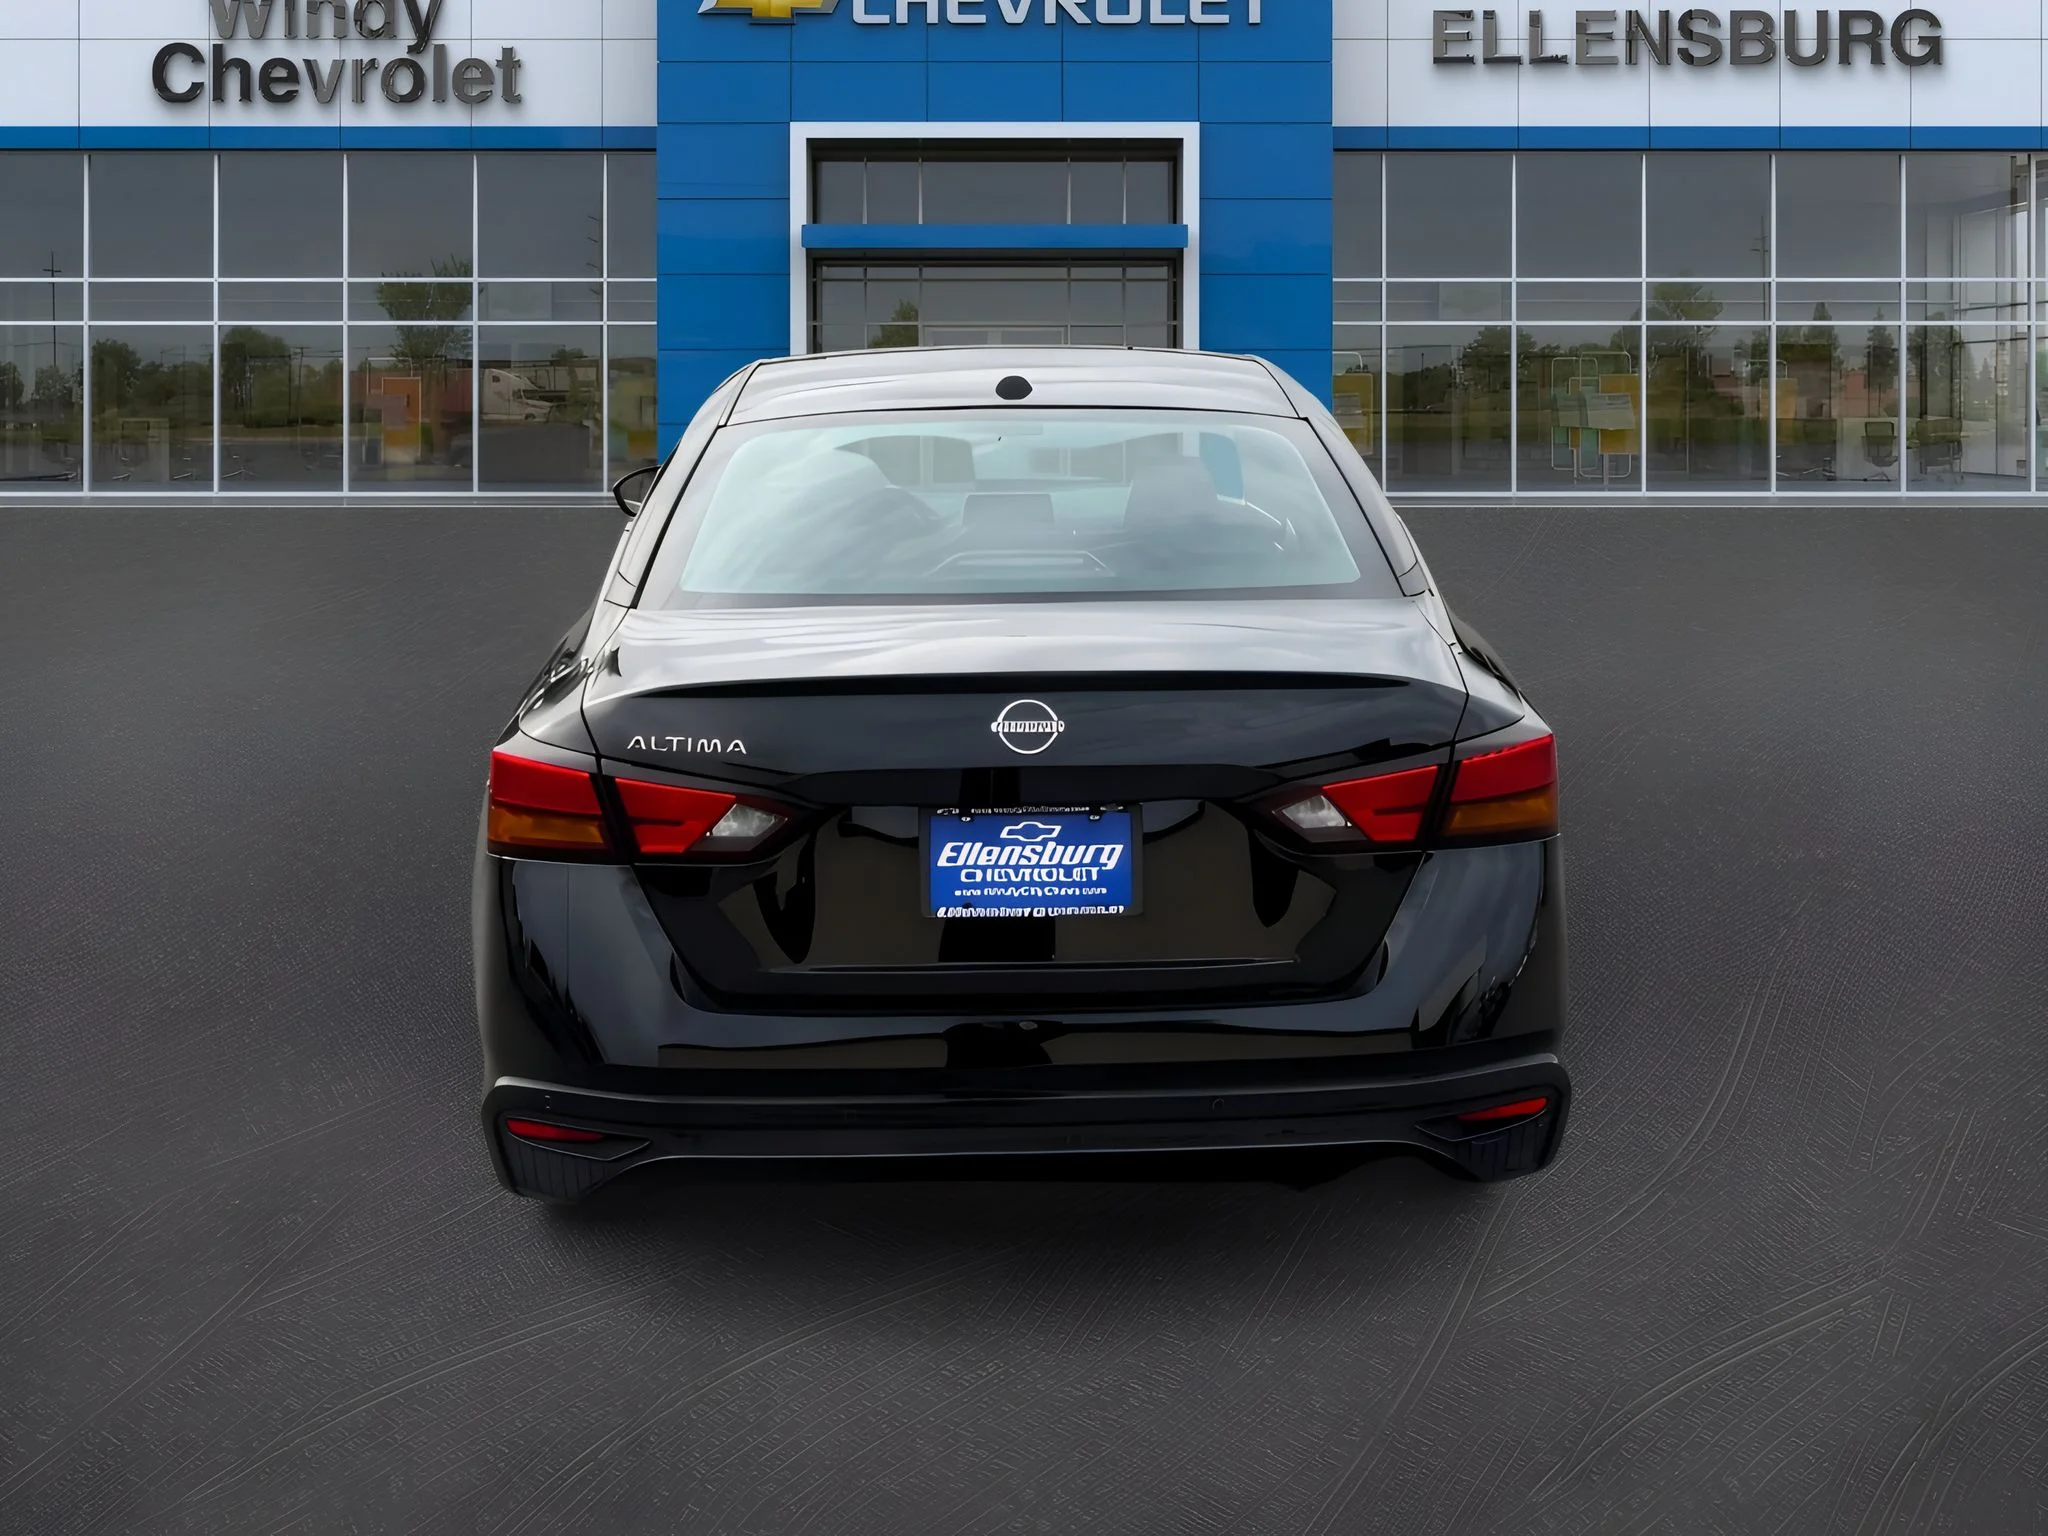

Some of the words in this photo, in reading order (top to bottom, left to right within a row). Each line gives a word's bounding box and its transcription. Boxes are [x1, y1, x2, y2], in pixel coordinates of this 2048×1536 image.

[209, 0, 442, 54] Windy
[1432, 8, 1943, 66] ELLENSBURG
[151, 42, 523, 104] Chevrolet
[627, 735, 747, 755] ALTIMA
[937, 841, 1124, 870] Ellensburg
